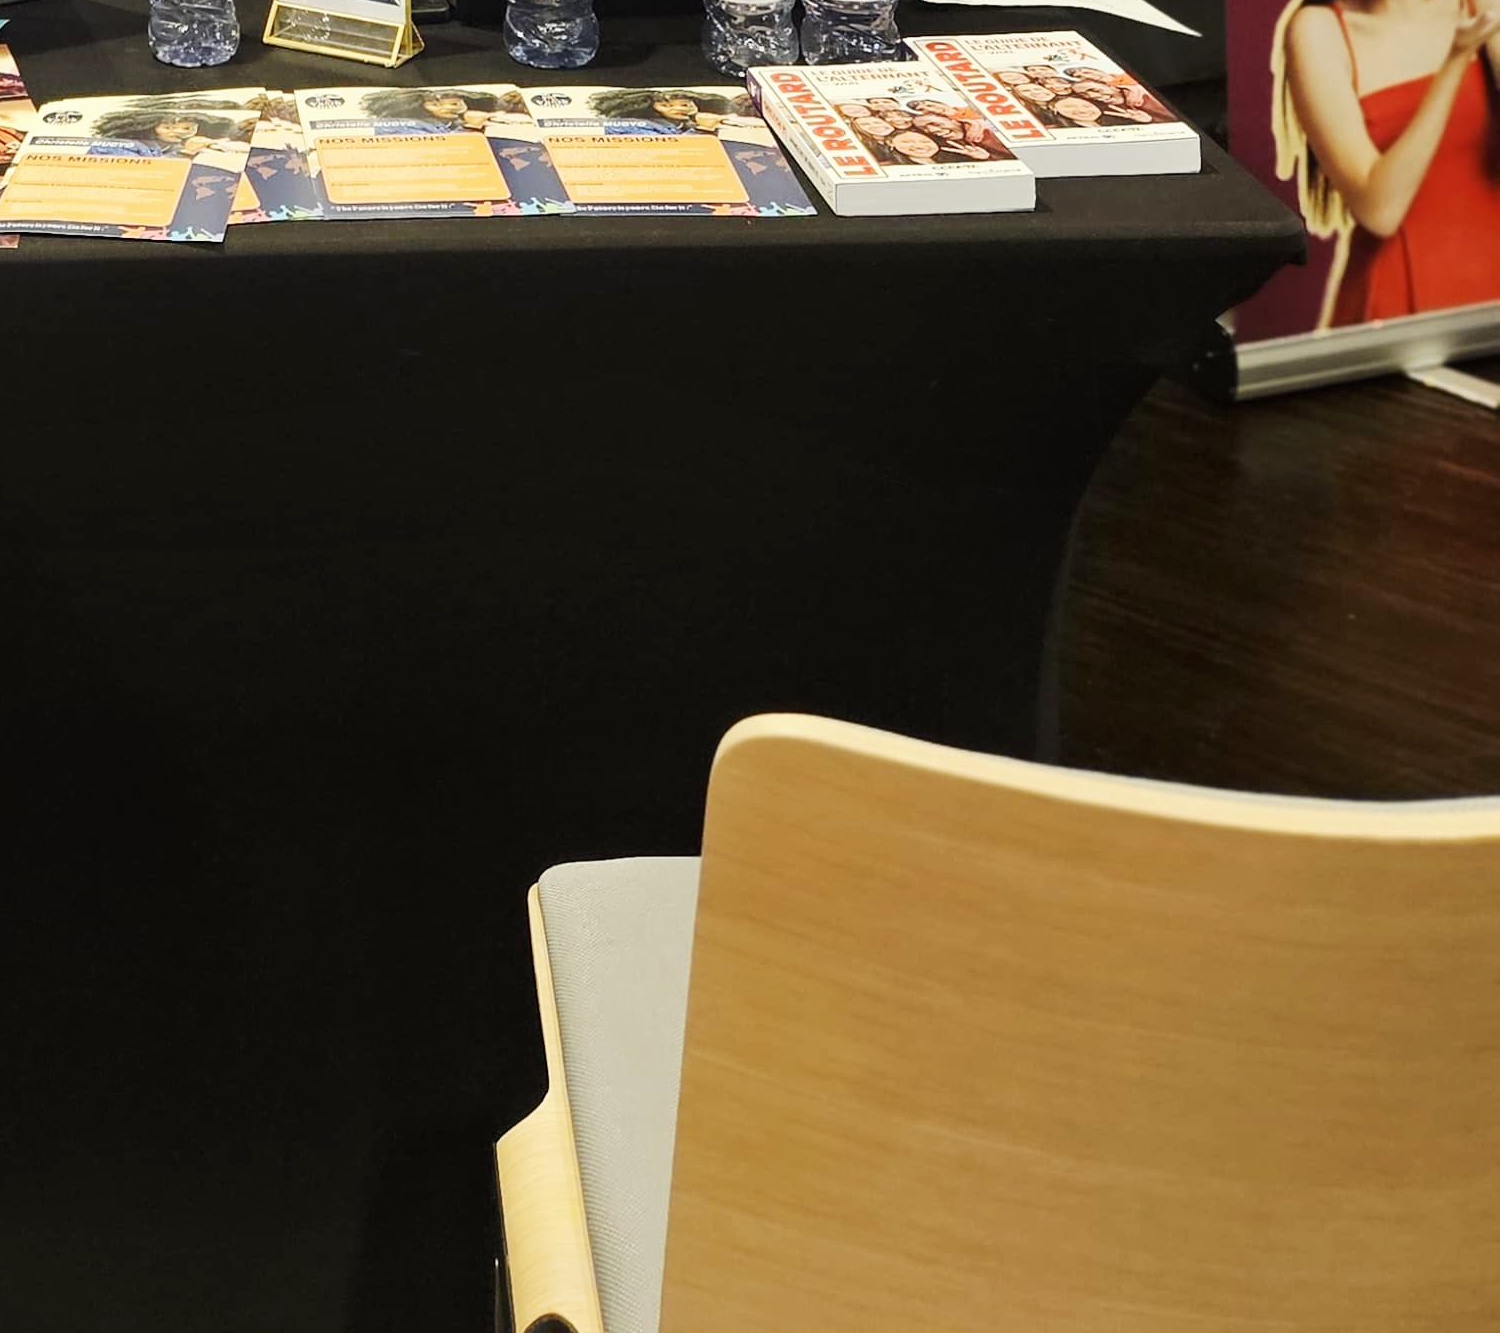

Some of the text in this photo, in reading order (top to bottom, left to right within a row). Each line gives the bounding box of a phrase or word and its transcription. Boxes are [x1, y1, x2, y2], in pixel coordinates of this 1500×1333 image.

[971, 40, 1082, 51] L'ALTERNANT
[816, 70, 931, 83] L'ALTERNANT
[831, 68, 873, 76] GUIDE
[925, 42, 1023, 116] ROUTARD
[769, 72, 859, 151] ROUTARD
[1001, 119, 1046, 140] LE
[318, 135, 447, 145] NOS MISSIONS
[548, 135, 680, 144] NOS MISSIONS
[25, 154, 152, 166] NOS MISSIONS
[833, 155, 879, 176] LE
